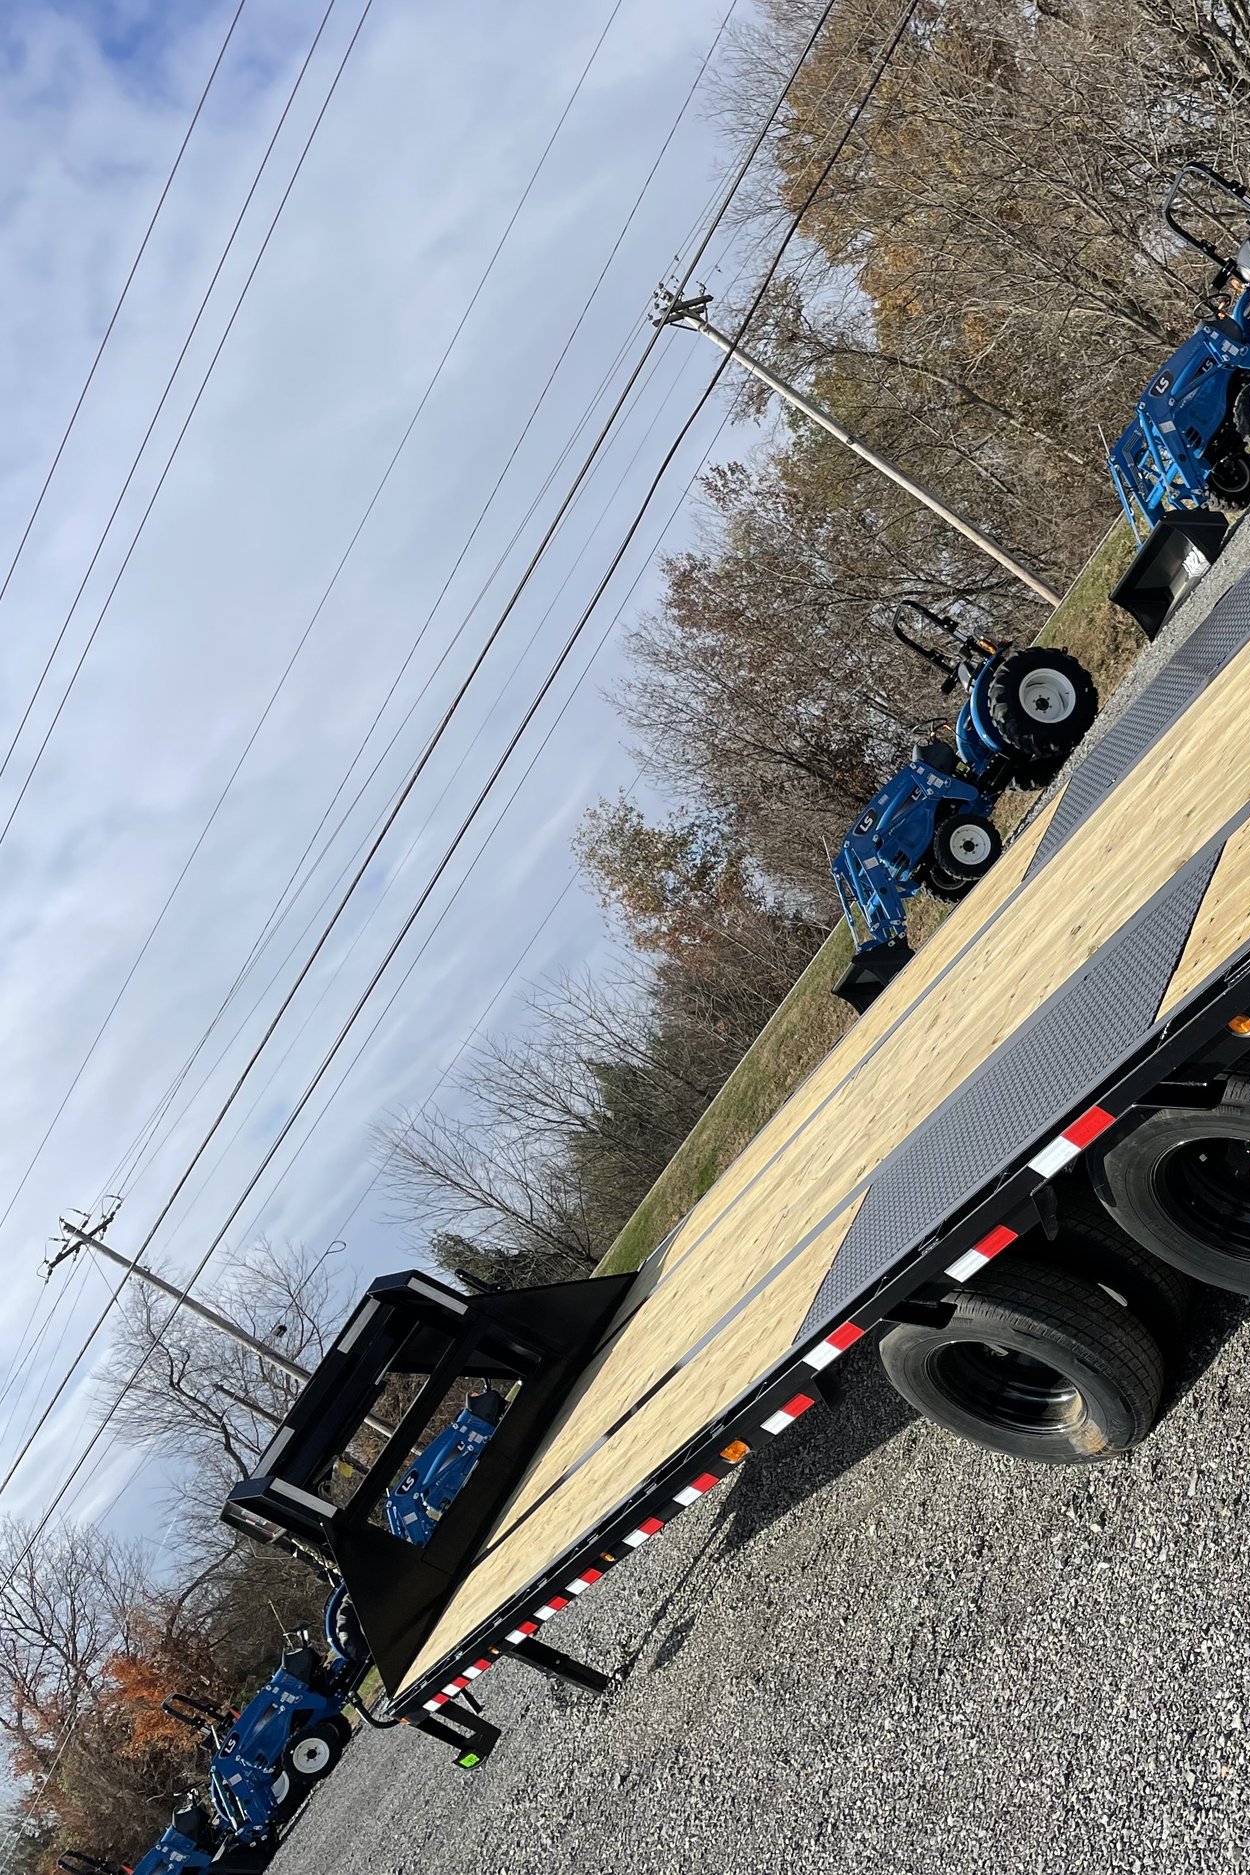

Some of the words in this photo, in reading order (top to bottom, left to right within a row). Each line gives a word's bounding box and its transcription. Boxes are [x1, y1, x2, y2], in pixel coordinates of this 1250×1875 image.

[1155, 377, 1170, 394] LS
[860, 815, 873, 832] LS
[401, 1476, 416, 1492] LS
[225, 1738, 237, 1754] LS
